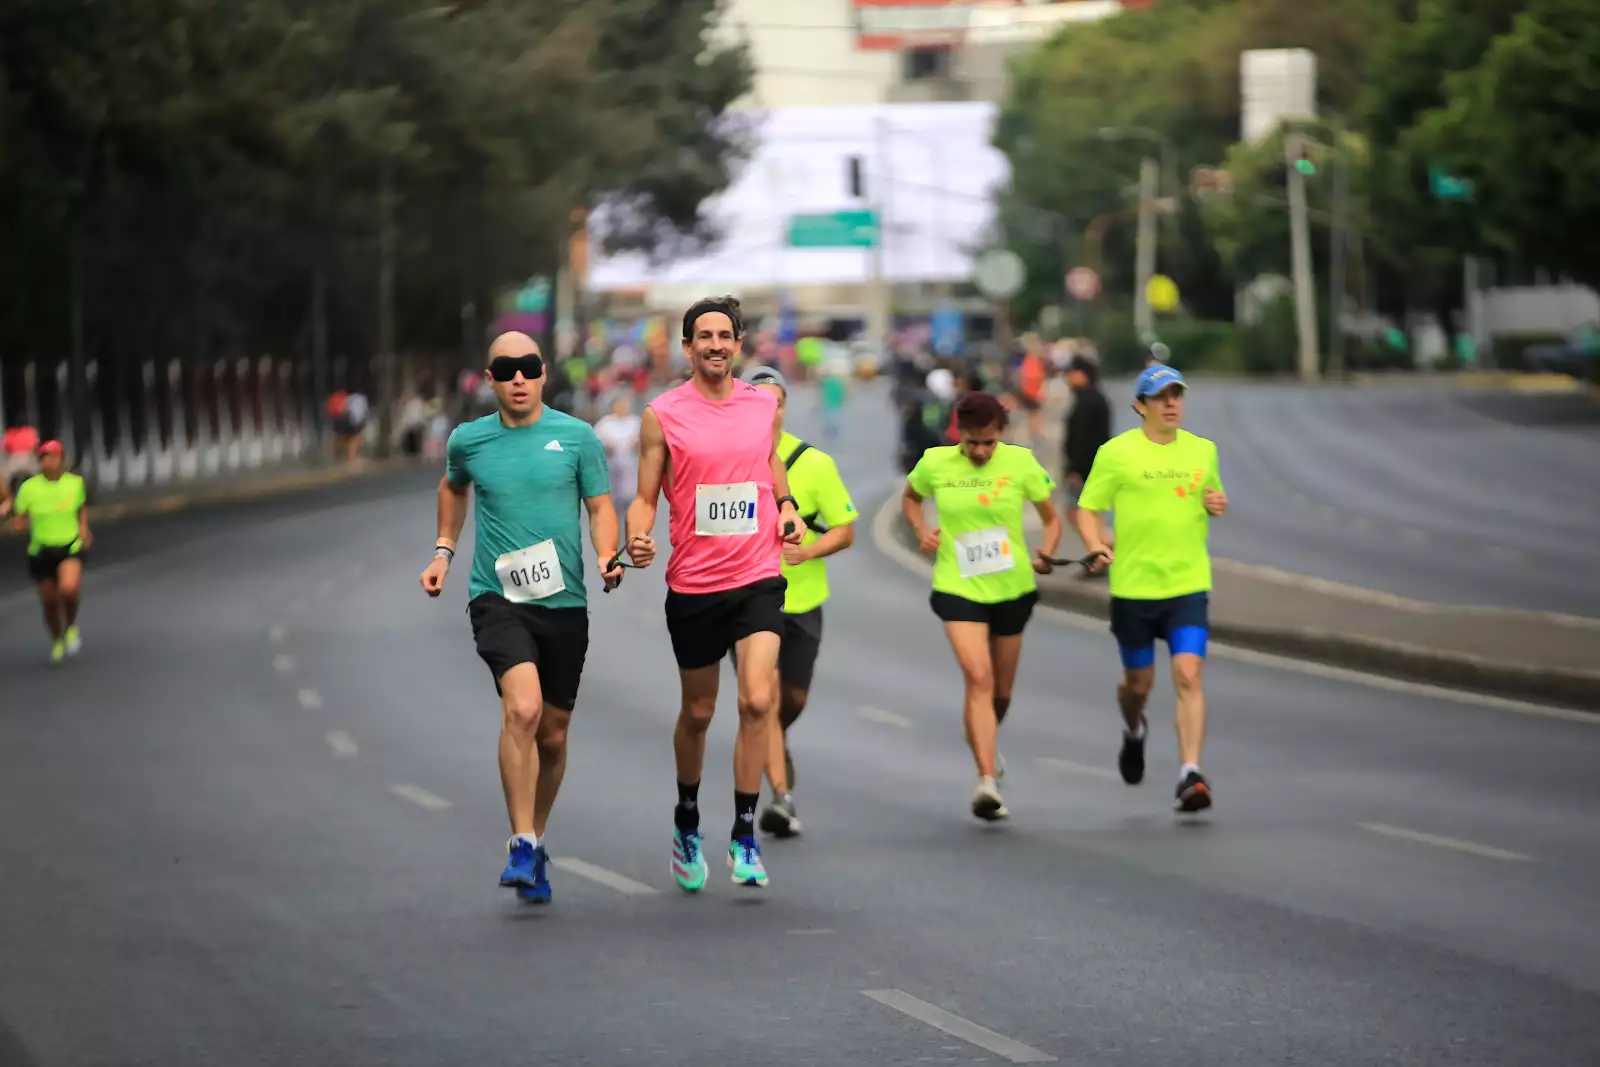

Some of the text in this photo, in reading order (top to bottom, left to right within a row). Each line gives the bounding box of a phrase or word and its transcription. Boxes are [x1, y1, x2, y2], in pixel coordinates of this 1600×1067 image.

[944, 477, 993, 488] Achilles
[709, 500, 747, 520] 0169
[510, 560, 550, 587] 0165
